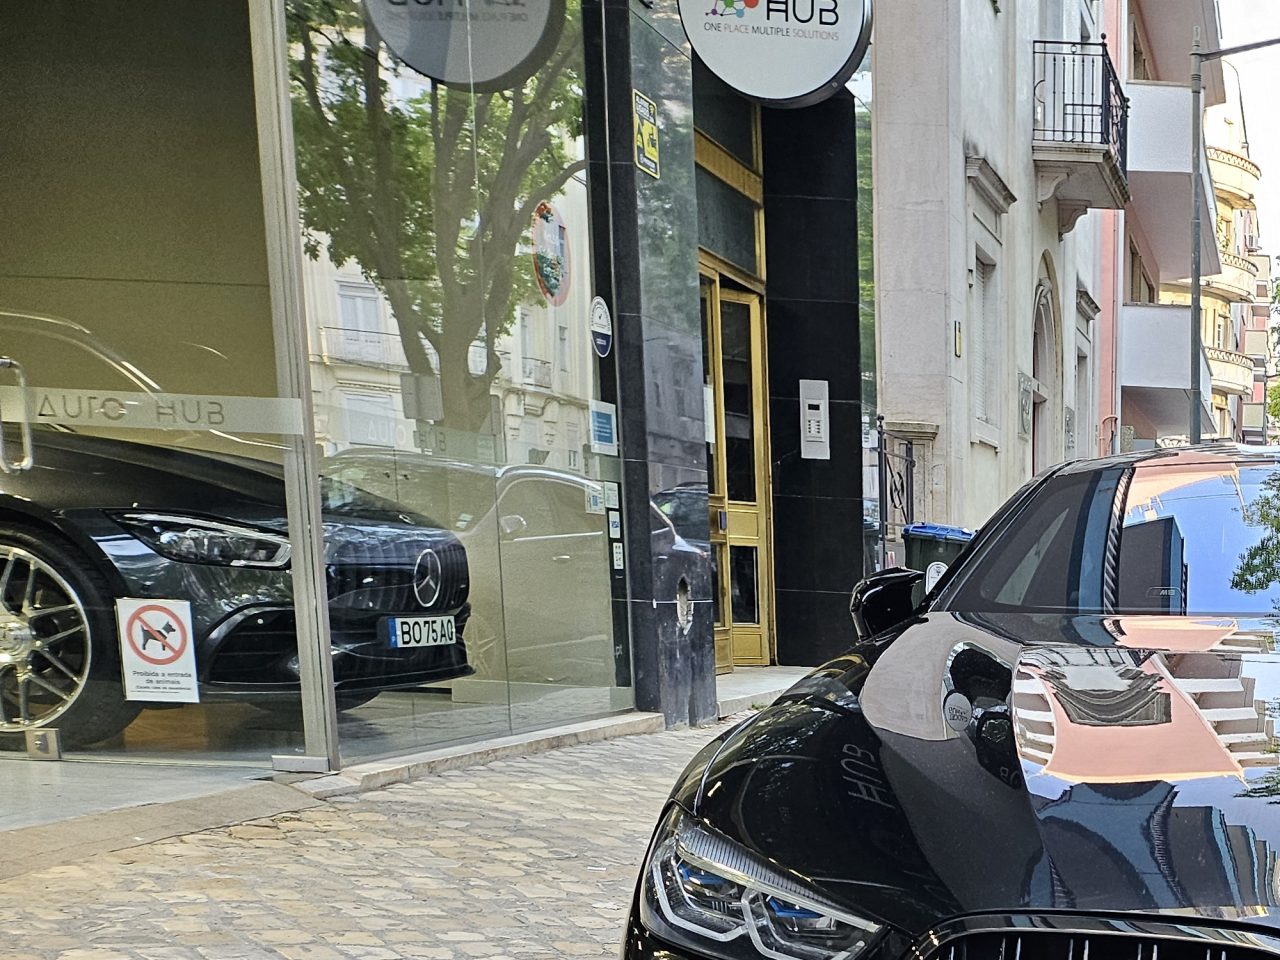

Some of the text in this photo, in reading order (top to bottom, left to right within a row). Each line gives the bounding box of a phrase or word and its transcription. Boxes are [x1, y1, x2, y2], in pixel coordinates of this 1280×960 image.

[766, 0, 840, 26] HUB
[704, 22, 840, 41] ONE PLACE MULTIPLE SOLUTIONS
[38, 394, 225, 425] AUTO HUB
[400, 621, 422, 645] BO
[423, 620, 439, 644] 75
